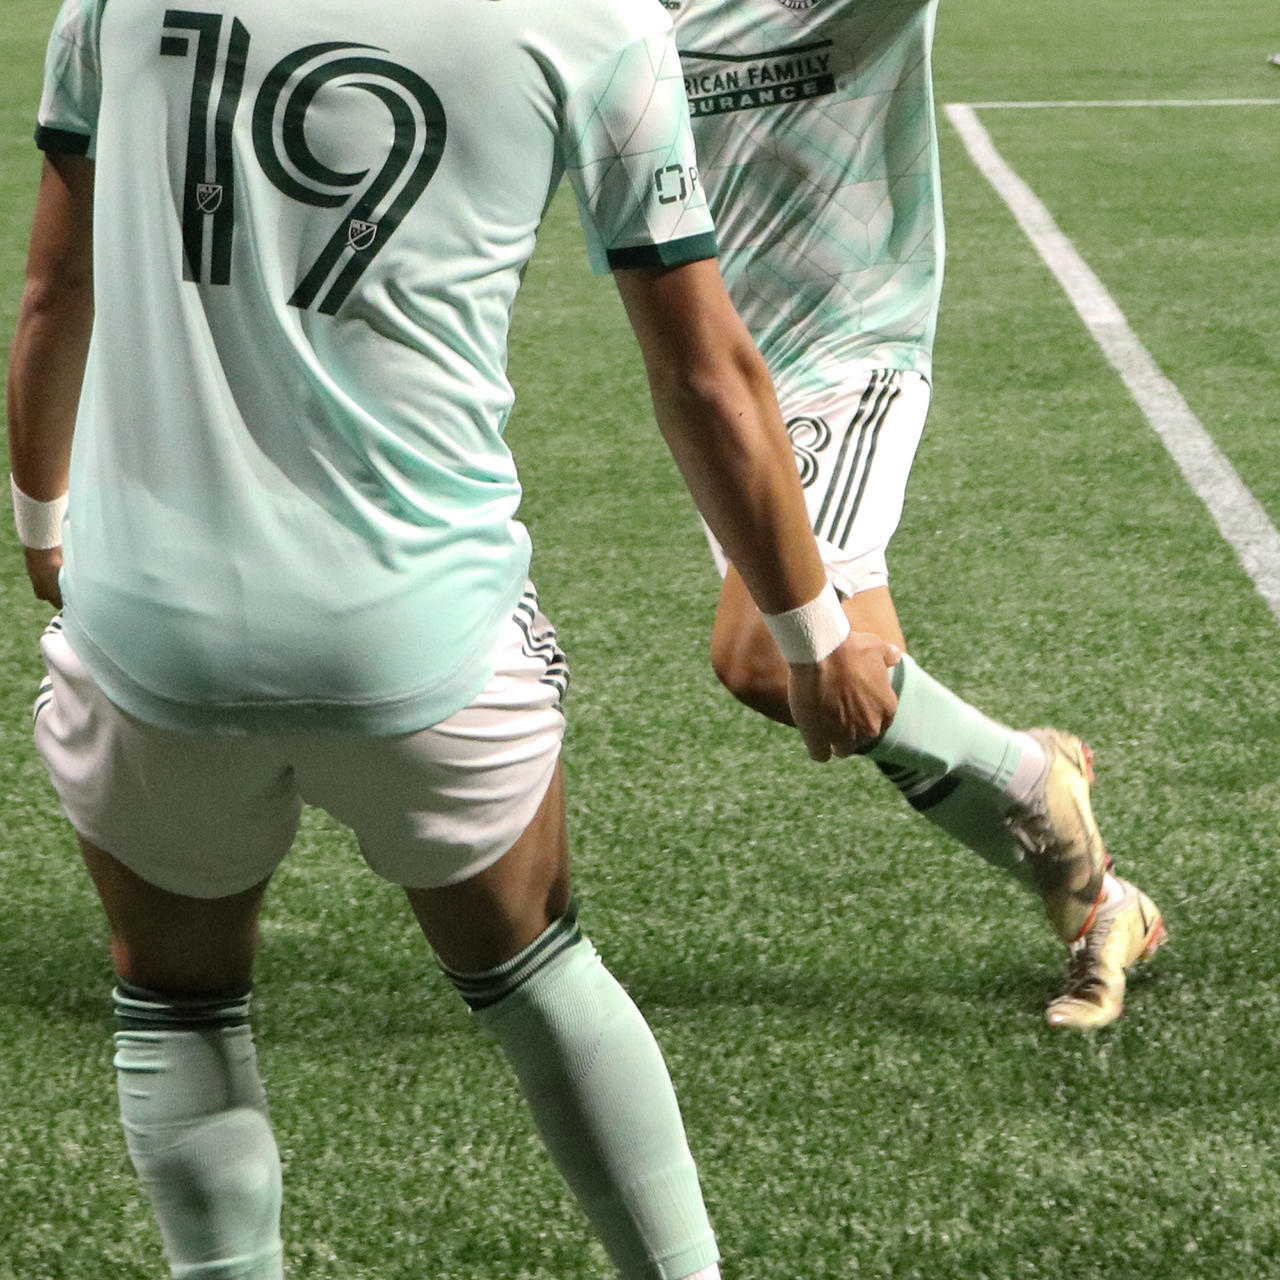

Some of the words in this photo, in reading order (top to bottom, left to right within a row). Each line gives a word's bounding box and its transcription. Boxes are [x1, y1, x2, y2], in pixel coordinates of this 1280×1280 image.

[684, 70, 739, 96] RICAN
[746, 54, 831, 86] FAMILY
[689, 82, 819, 115] SURANCE
[160, 9, 447, 316] 19
